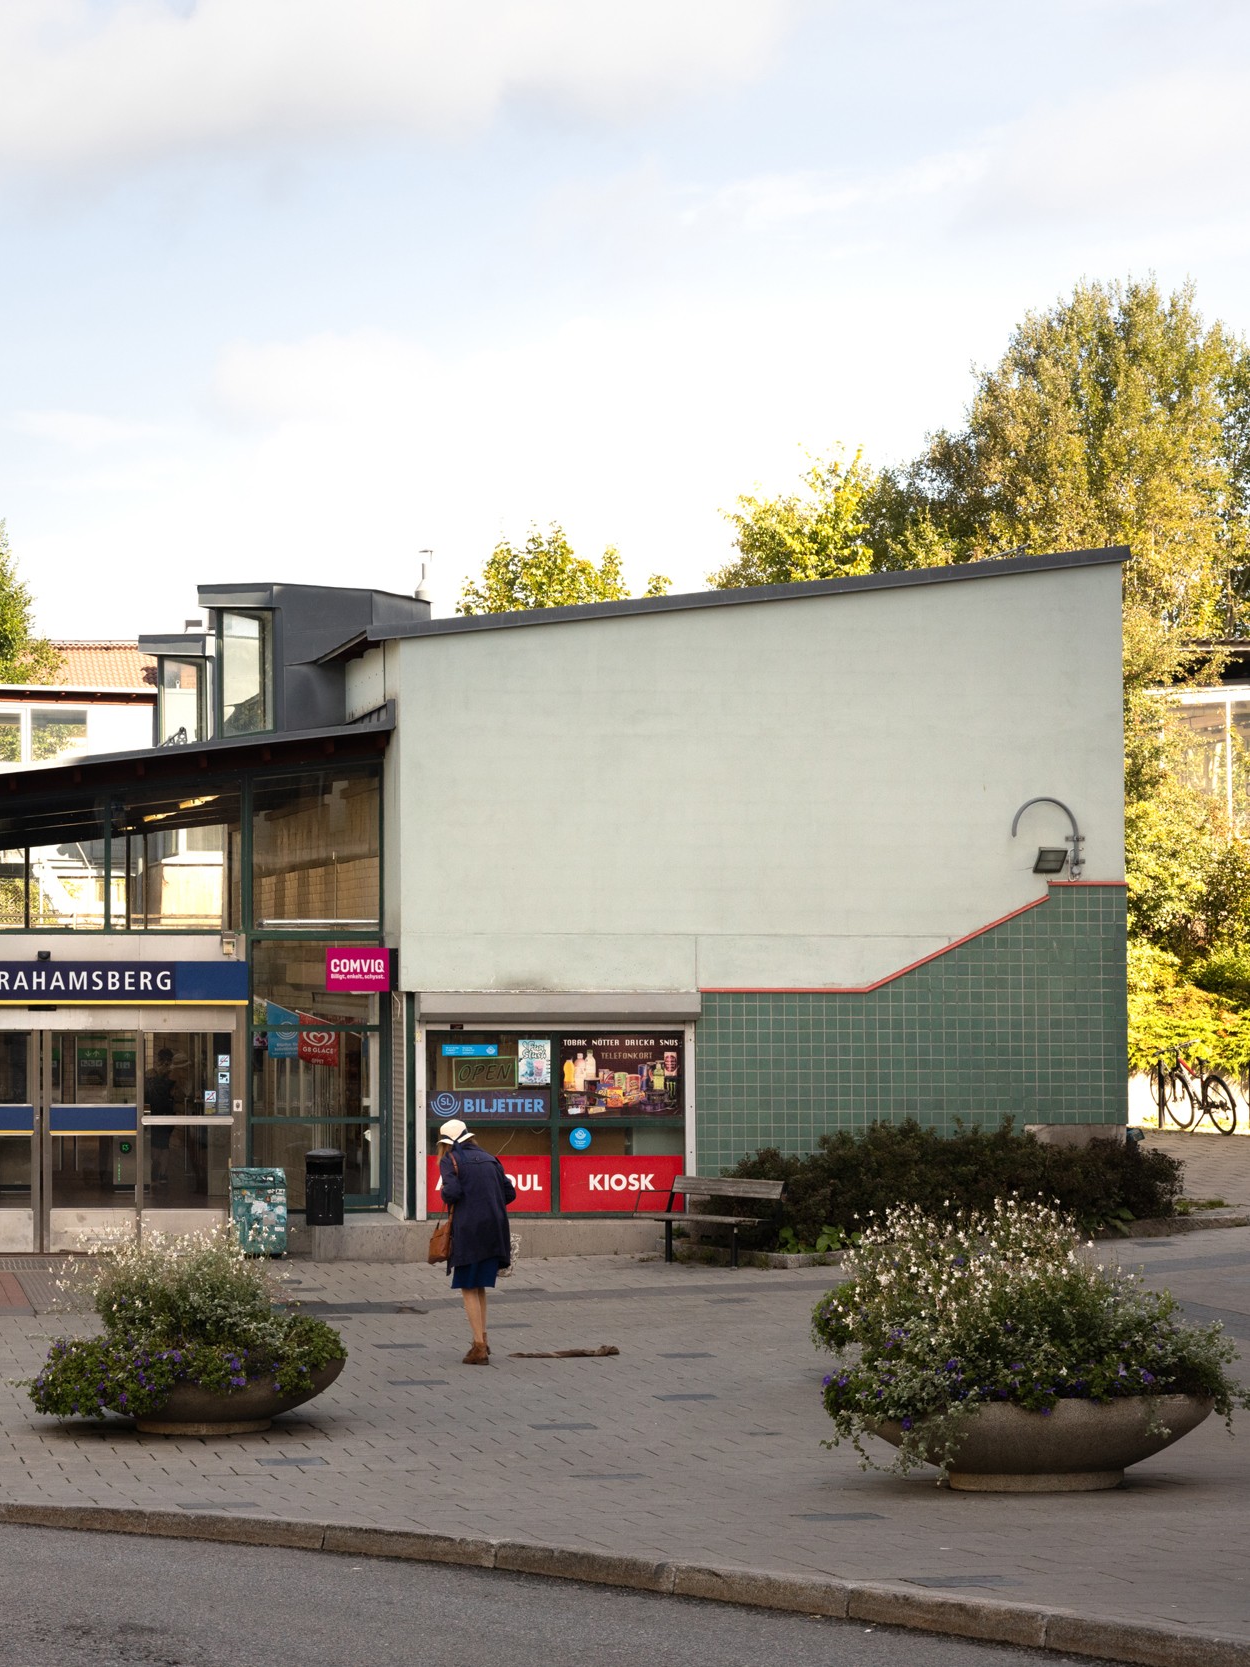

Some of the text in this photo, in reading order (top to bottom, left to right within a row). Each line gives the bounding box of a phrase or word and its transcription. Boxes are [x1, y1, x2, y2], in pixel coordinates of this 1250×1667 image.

[330, 958, 385, 973] COMVIQ
[591, 1038, 620, 1046] NÖTTER
[659, 1039, 679, 1047] SNUS
[601, 1052, 653, 1060] TELEFONKORT
[459, 1063, 513, 1083] OPEN
[440, 1097, 545, 1113] SL BILJETTER
[589, 1174, 655, 1191] KIOSK
